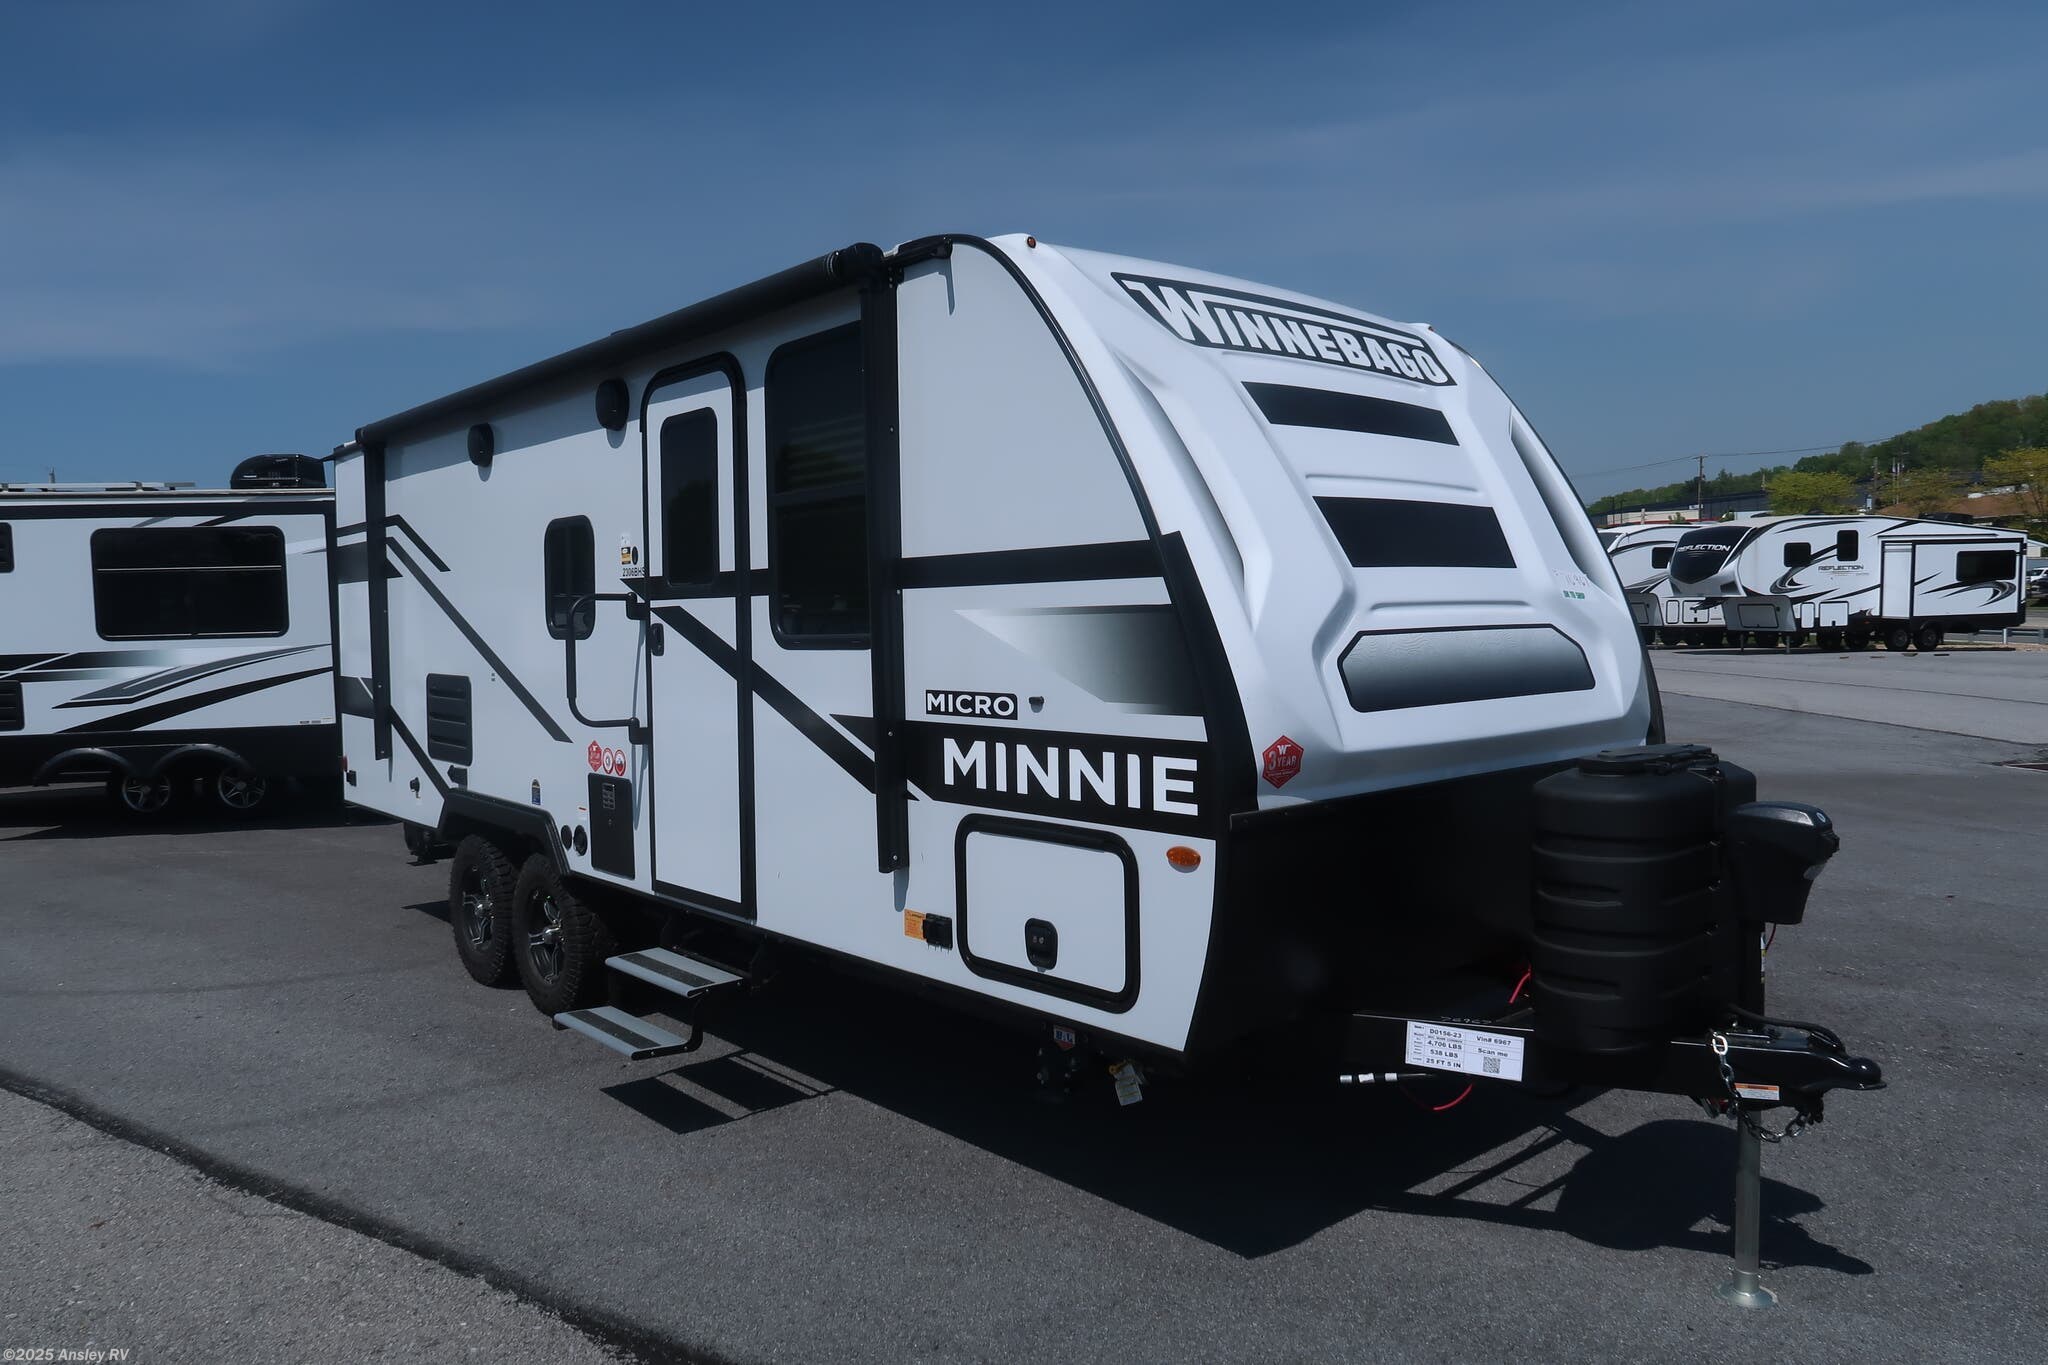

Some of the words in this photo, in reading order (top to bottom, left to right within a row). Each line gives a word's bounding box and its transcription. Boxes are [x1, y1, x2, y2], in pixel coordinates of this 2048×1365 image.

[1122, 280, 1448, 384] WINNEBAGO
[927, 693, 1014, 716] MICRO
[944, 738, 1198, 816] MINNIE
[1278, 755, 1297, 768] YEAR
